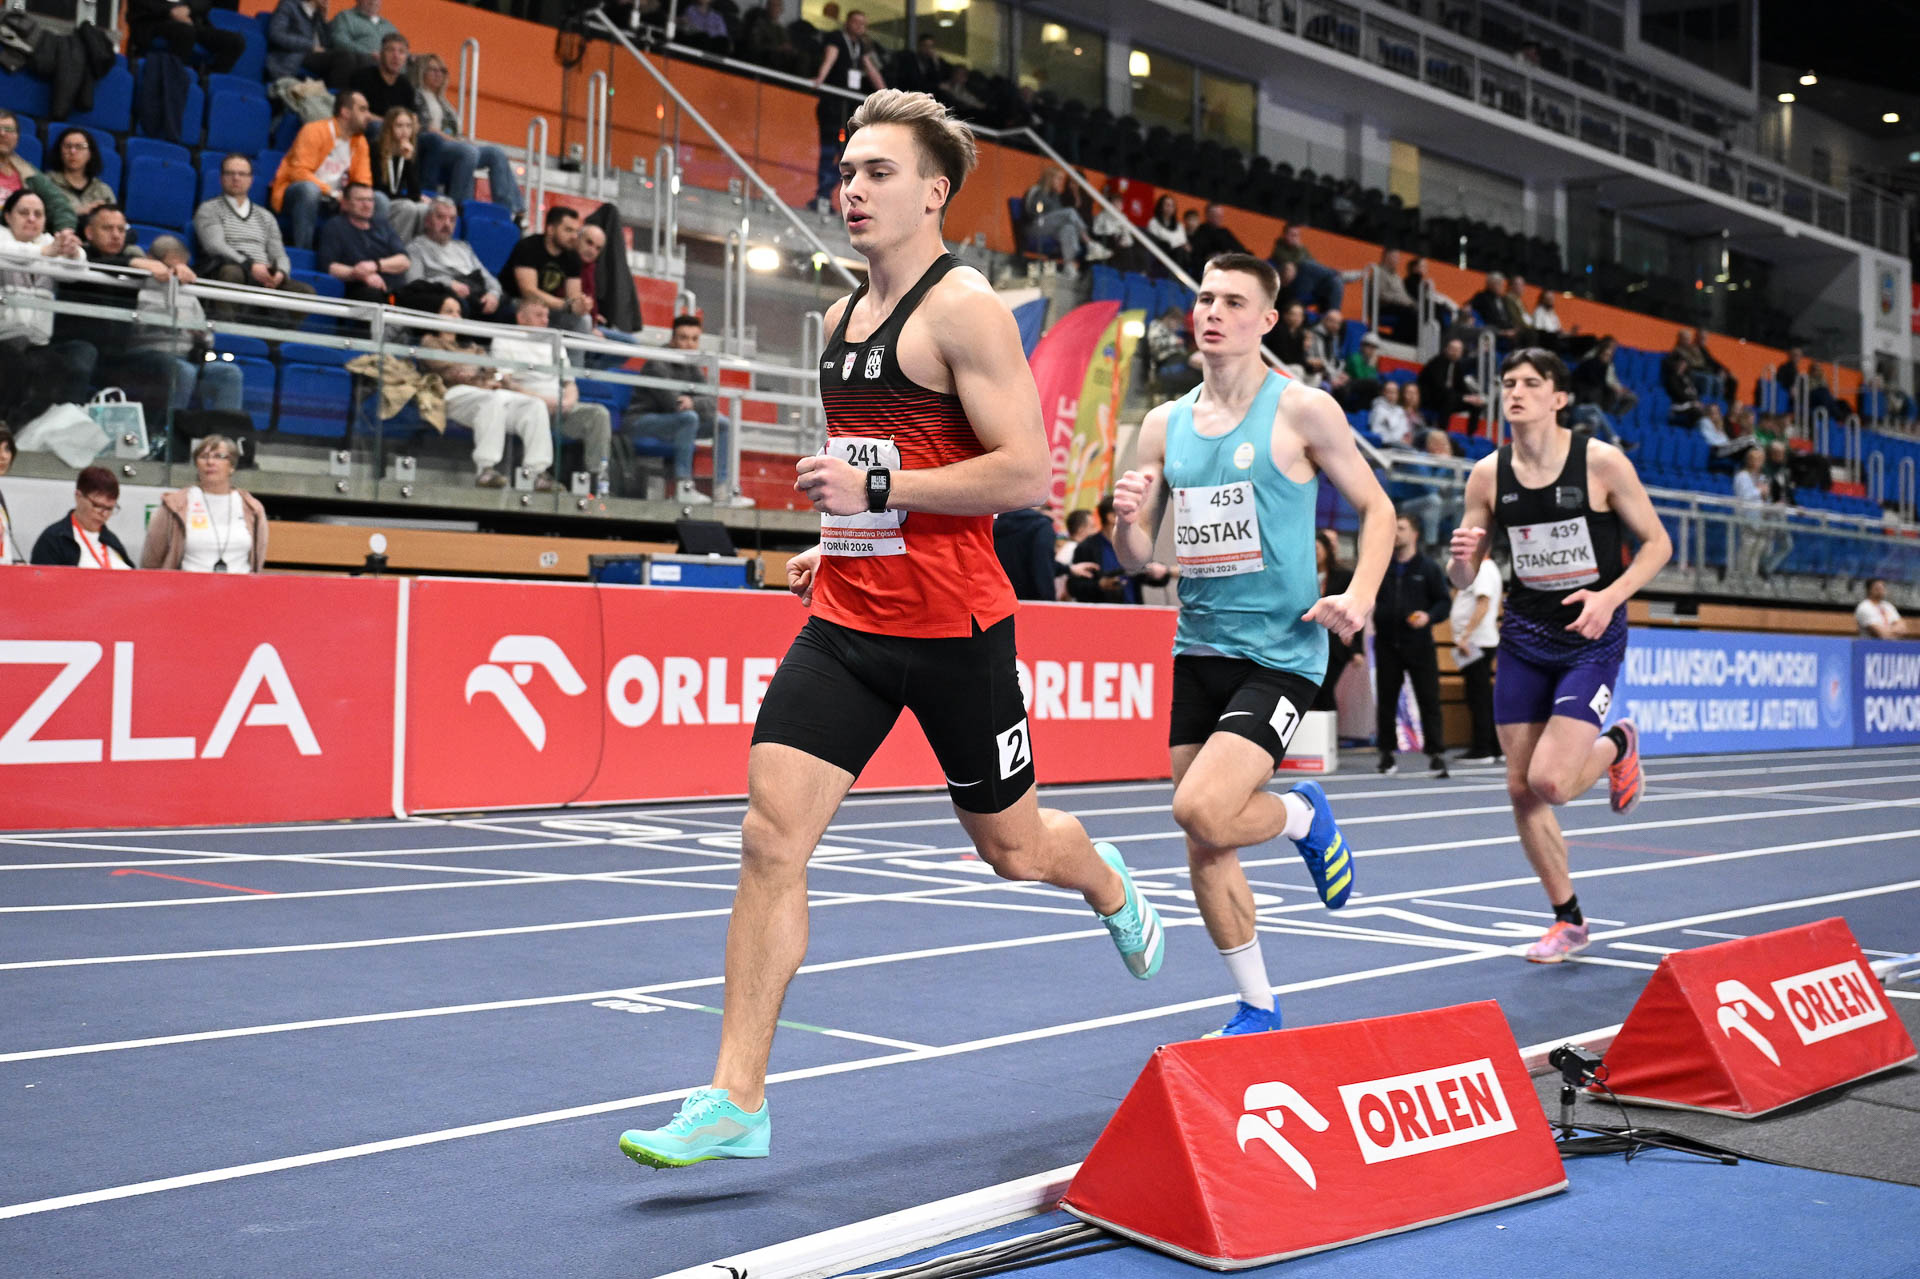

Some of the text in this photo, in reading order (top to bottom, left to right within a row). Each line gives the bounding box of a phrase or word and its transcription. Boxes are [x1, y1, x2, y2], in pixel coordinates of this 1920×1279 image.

[846, 443, 882, 467] 241
[1210, 487, 1244, 508] 453
[1177, 519, 1253, 545] SZOSTAK
[1550, 522, 1579, 540] 439
[823, 540, 874, 552] TORUŃ 2026
[1516, 545, 1590, 569] STAŃCZYK
[1216, 563, 1238, 573] 2026
[1624, 646, 1819, 687] KUJAWSKO-POMORSKI
[606, 654, 786, 728] ORLE
[1281, 711, 1296, 737] 1
[1700, 699, 1759, 733] LEKKIEJ
[1760, 699, 1819, 731] ATLETYKI
[1007, 728, 1026, 773] 2
[1786, 971, 1876, 1032] ORLEN
[1358, 1072, 1502, 1148] ORLEN
